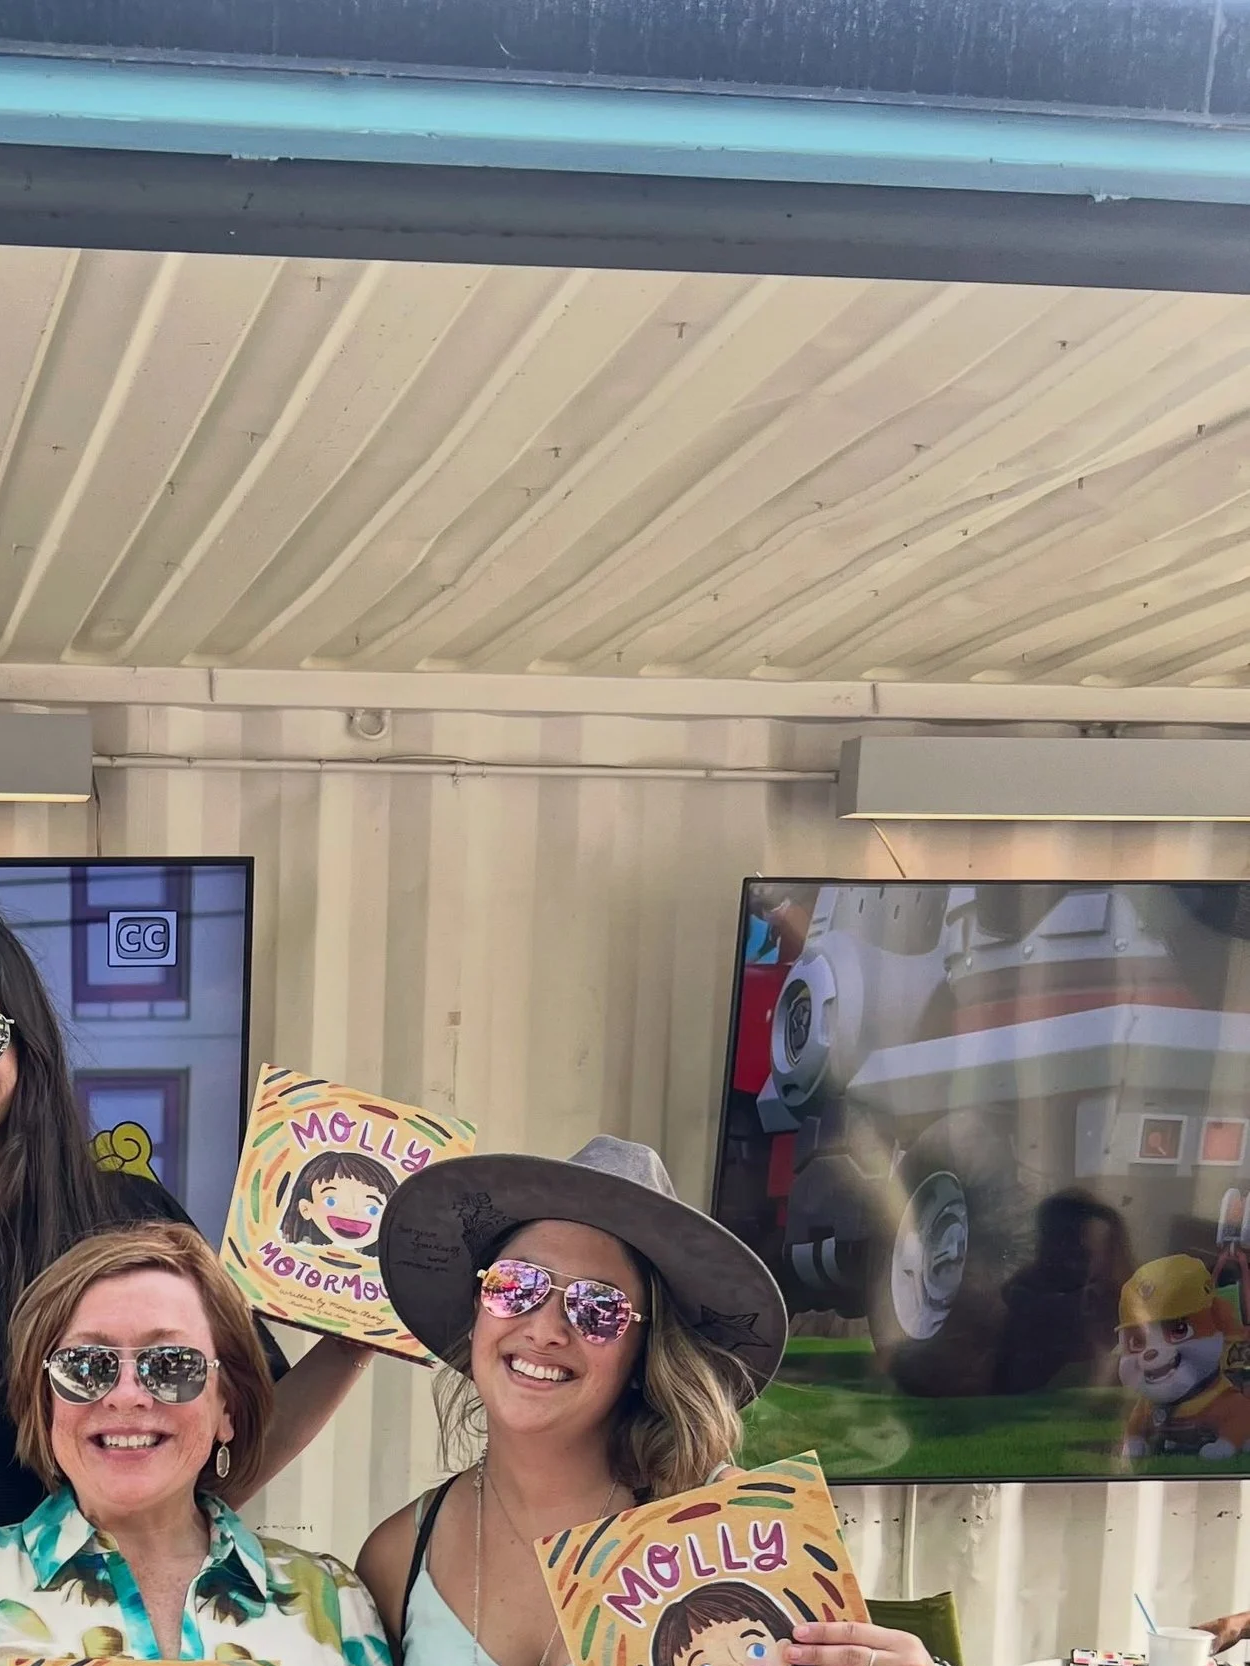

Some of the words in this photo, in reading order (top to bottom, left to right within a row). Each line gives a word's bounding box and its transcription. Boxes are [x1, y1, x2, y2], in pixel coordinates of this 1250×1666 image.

[291, 1112, 432, 1172] MOLLY
[259, 1242, 391, 1301] MOTORMOU
[605, 1520, 786, 1625] MOLLY
